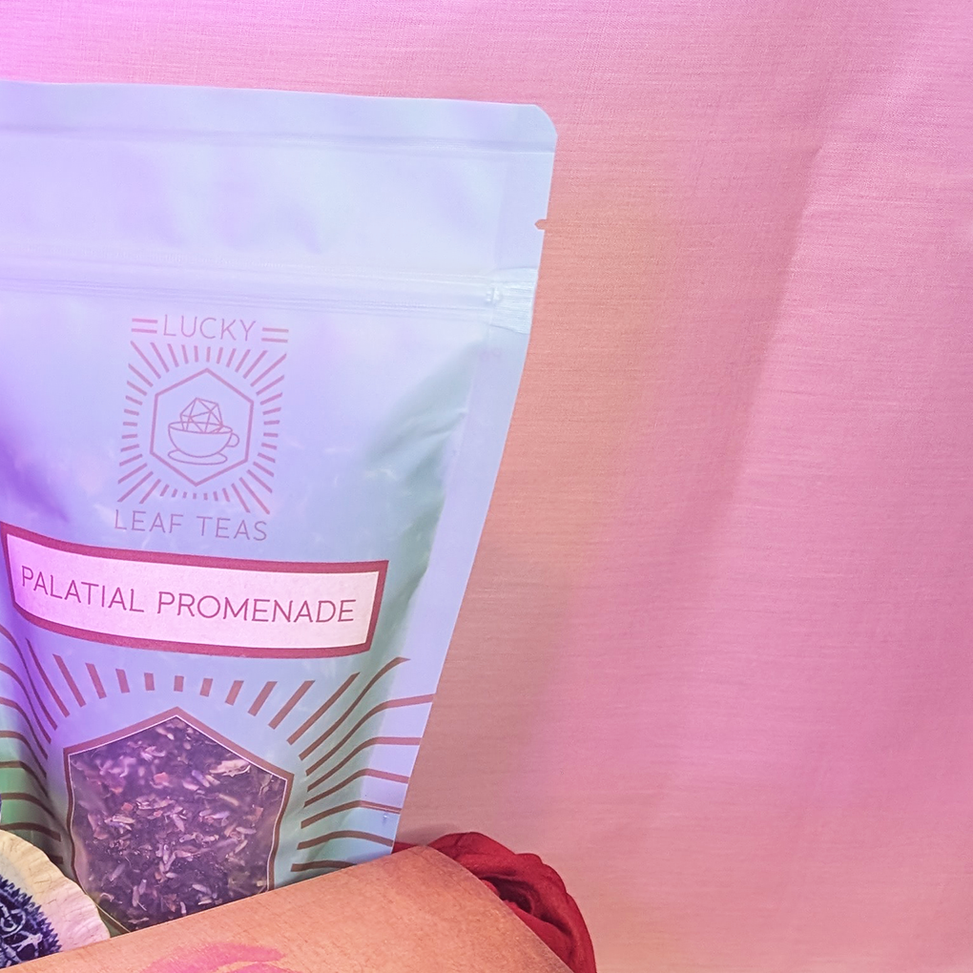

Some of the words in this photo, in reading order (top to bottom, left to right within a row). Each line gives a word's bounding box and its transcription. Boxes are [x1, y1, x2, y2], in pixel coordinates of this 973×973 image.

[163, 314, 256, 342] LUCKY
[114, 508, 184, 535] LEAF
[196, 515, 268, 542] TEAS
[20, 564, 145, 614] PALATIAL
[156, 590, 357, 624] PROMENADE
